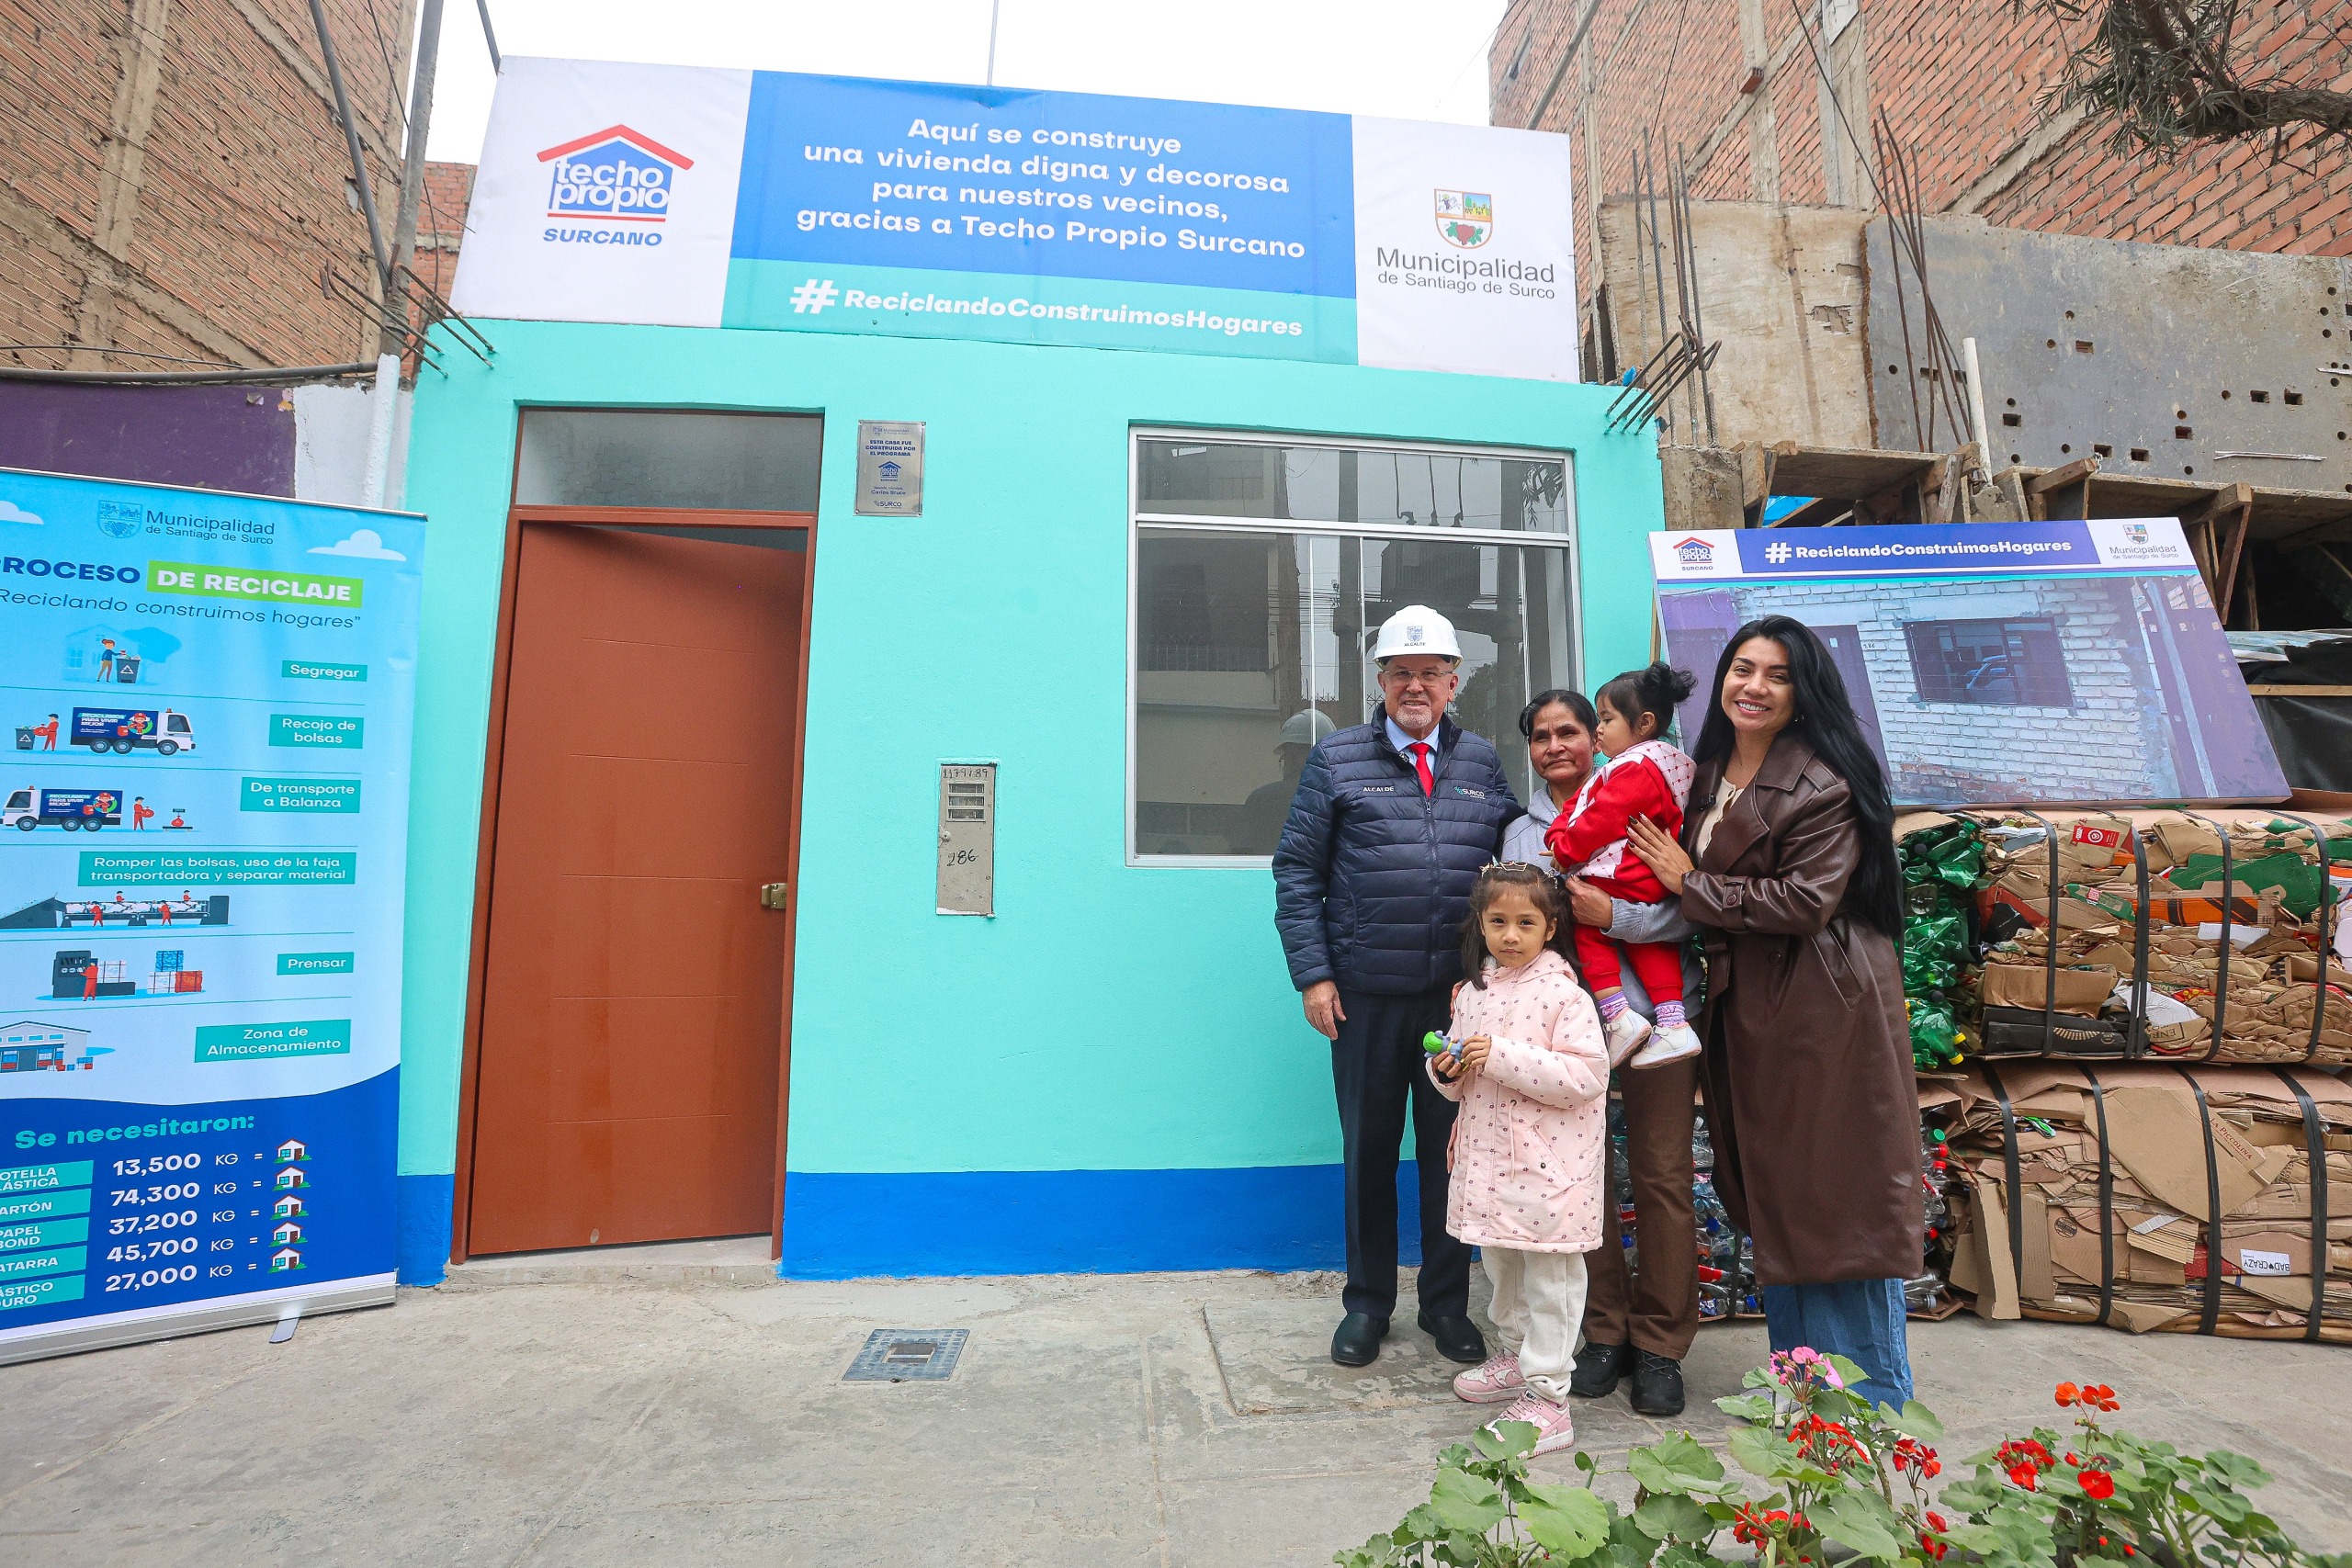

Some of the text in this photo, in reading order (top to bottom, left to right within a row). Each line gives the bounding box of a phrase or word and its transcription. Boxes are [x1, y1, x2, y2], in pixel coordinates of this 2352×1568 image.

[909, 117, 1182, 158] Aquí se construye
[556, 156, 663, 189] techo
[804, 145, 1290, 194] una vivienda digna y decorosa
[553, 178, 671, 213] propio
[871, 181, 1228, 223] para nuestros vecinos,
[542, 227, 662, 247] SURCANO
[797, 208, 1306, 259] gracias a Techo Propio Surcano
[1377, 246, 1555, 285] Municipalidad
[1378, 272, 1555, 299] de Santiago de Surco
[145, 509, 276, 536] Municipalidad
[145, 525, 274, 545] de Santiago de Surco
[1679, 546, 1709, 555] techo
[1679, 553, 1713, 562] propio
[2109, 545, 2177, 555] Municipalidad
[0, 555, 352, 602] ROCESO DE RECICLAJE
[135, 601, 266, 623] construimos
[289, 663, 360, 681] Segregar
[281, 717, 356, 733] Recojo de
[293, 731, 343, 745] bolsas
[250, 781, 356, 798] De transporte
[1462, 788, 1485, 797] SURCO
[263, 795, 342, 808] a Balanza
[94, 856, 341, 871] Romper las bolsas, uso de la faja
[946, 849, 978, 867] 286
[90, 869, 345, 884] transportadora y separar material
[287, 956, 347, 970] Prensar
[243, 1025, 309, 1041] Zona de
[207, 1037, 342, 1056] Almacenamiento
[15, 1114, 255, 1150] Se necesitaron:
[2210, 1117, 2220, 1129] LA
[2219, 1126, 2253, 1160] PICCOLINA
[113, 1153, 201, 1177] 13,500
[215, 1153, 239, 1167] KG
[0, 1177, 60, 1191] ÁSTICA
[110, 1181, 200, 1207] 74,300
[213, 1181, 237, 1196] KG
[108, 1210, 198, 1235] 37,200
[212, 1210, 235, 1223] KG
[107, 1236, 198, 1263] 45,700
[210, 1238, 234, 1252] KG
[106, 1265, 198, 1292] 27,000
[209, 1264, 233, 1278] KG
